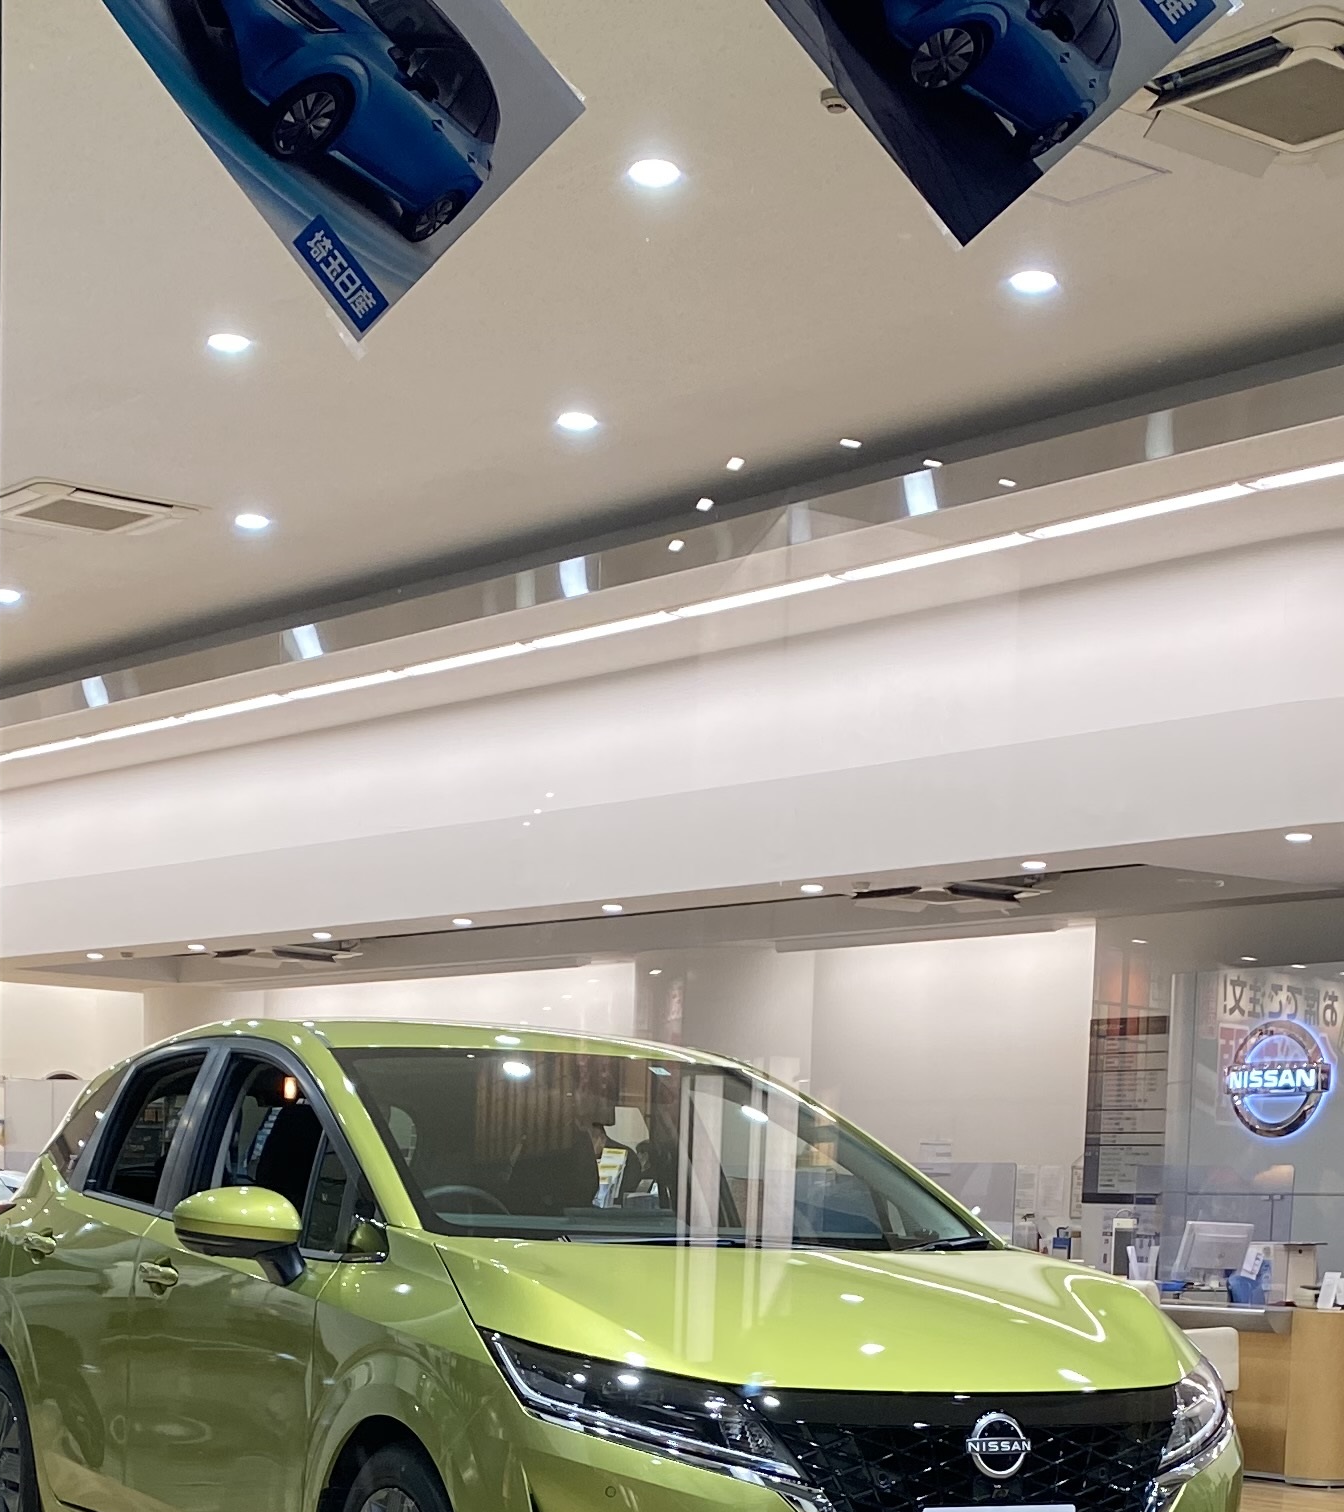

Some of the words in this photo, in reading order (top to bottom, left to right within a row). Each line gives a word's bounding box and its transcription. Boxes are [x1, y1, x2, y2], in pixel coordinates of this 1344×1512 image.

[306, 229, 377, 319] 埼玉日産
[1229, 1068, 1317, 1090] NISSAN
[967, 1440, 1032, 1452] NISSAN
